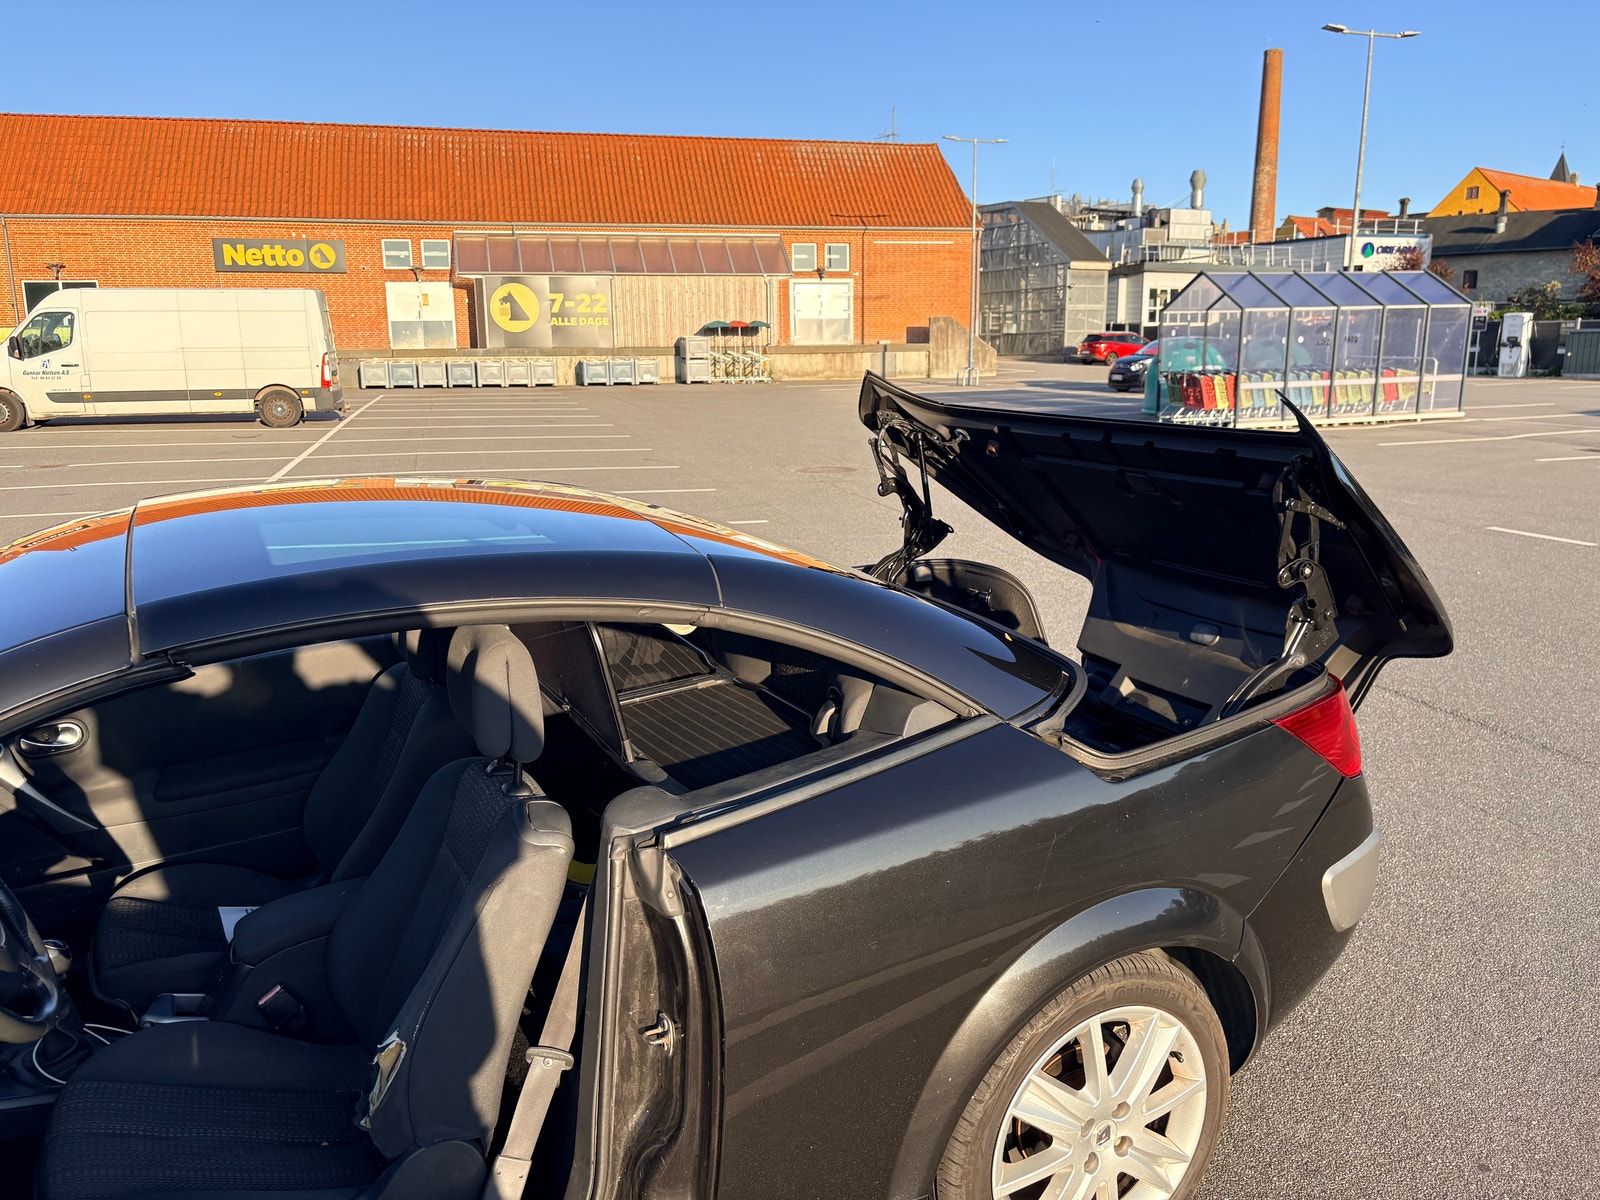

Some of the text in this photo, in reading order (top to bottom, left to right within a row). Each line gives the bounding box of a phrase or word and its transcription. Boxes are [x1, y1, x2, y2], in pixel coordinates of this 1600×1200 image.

[222, 243, 305, 267] Netto
[548, 293, 608, 313] 7-22
[550, 317, 609, 327] ALLE DAGE
